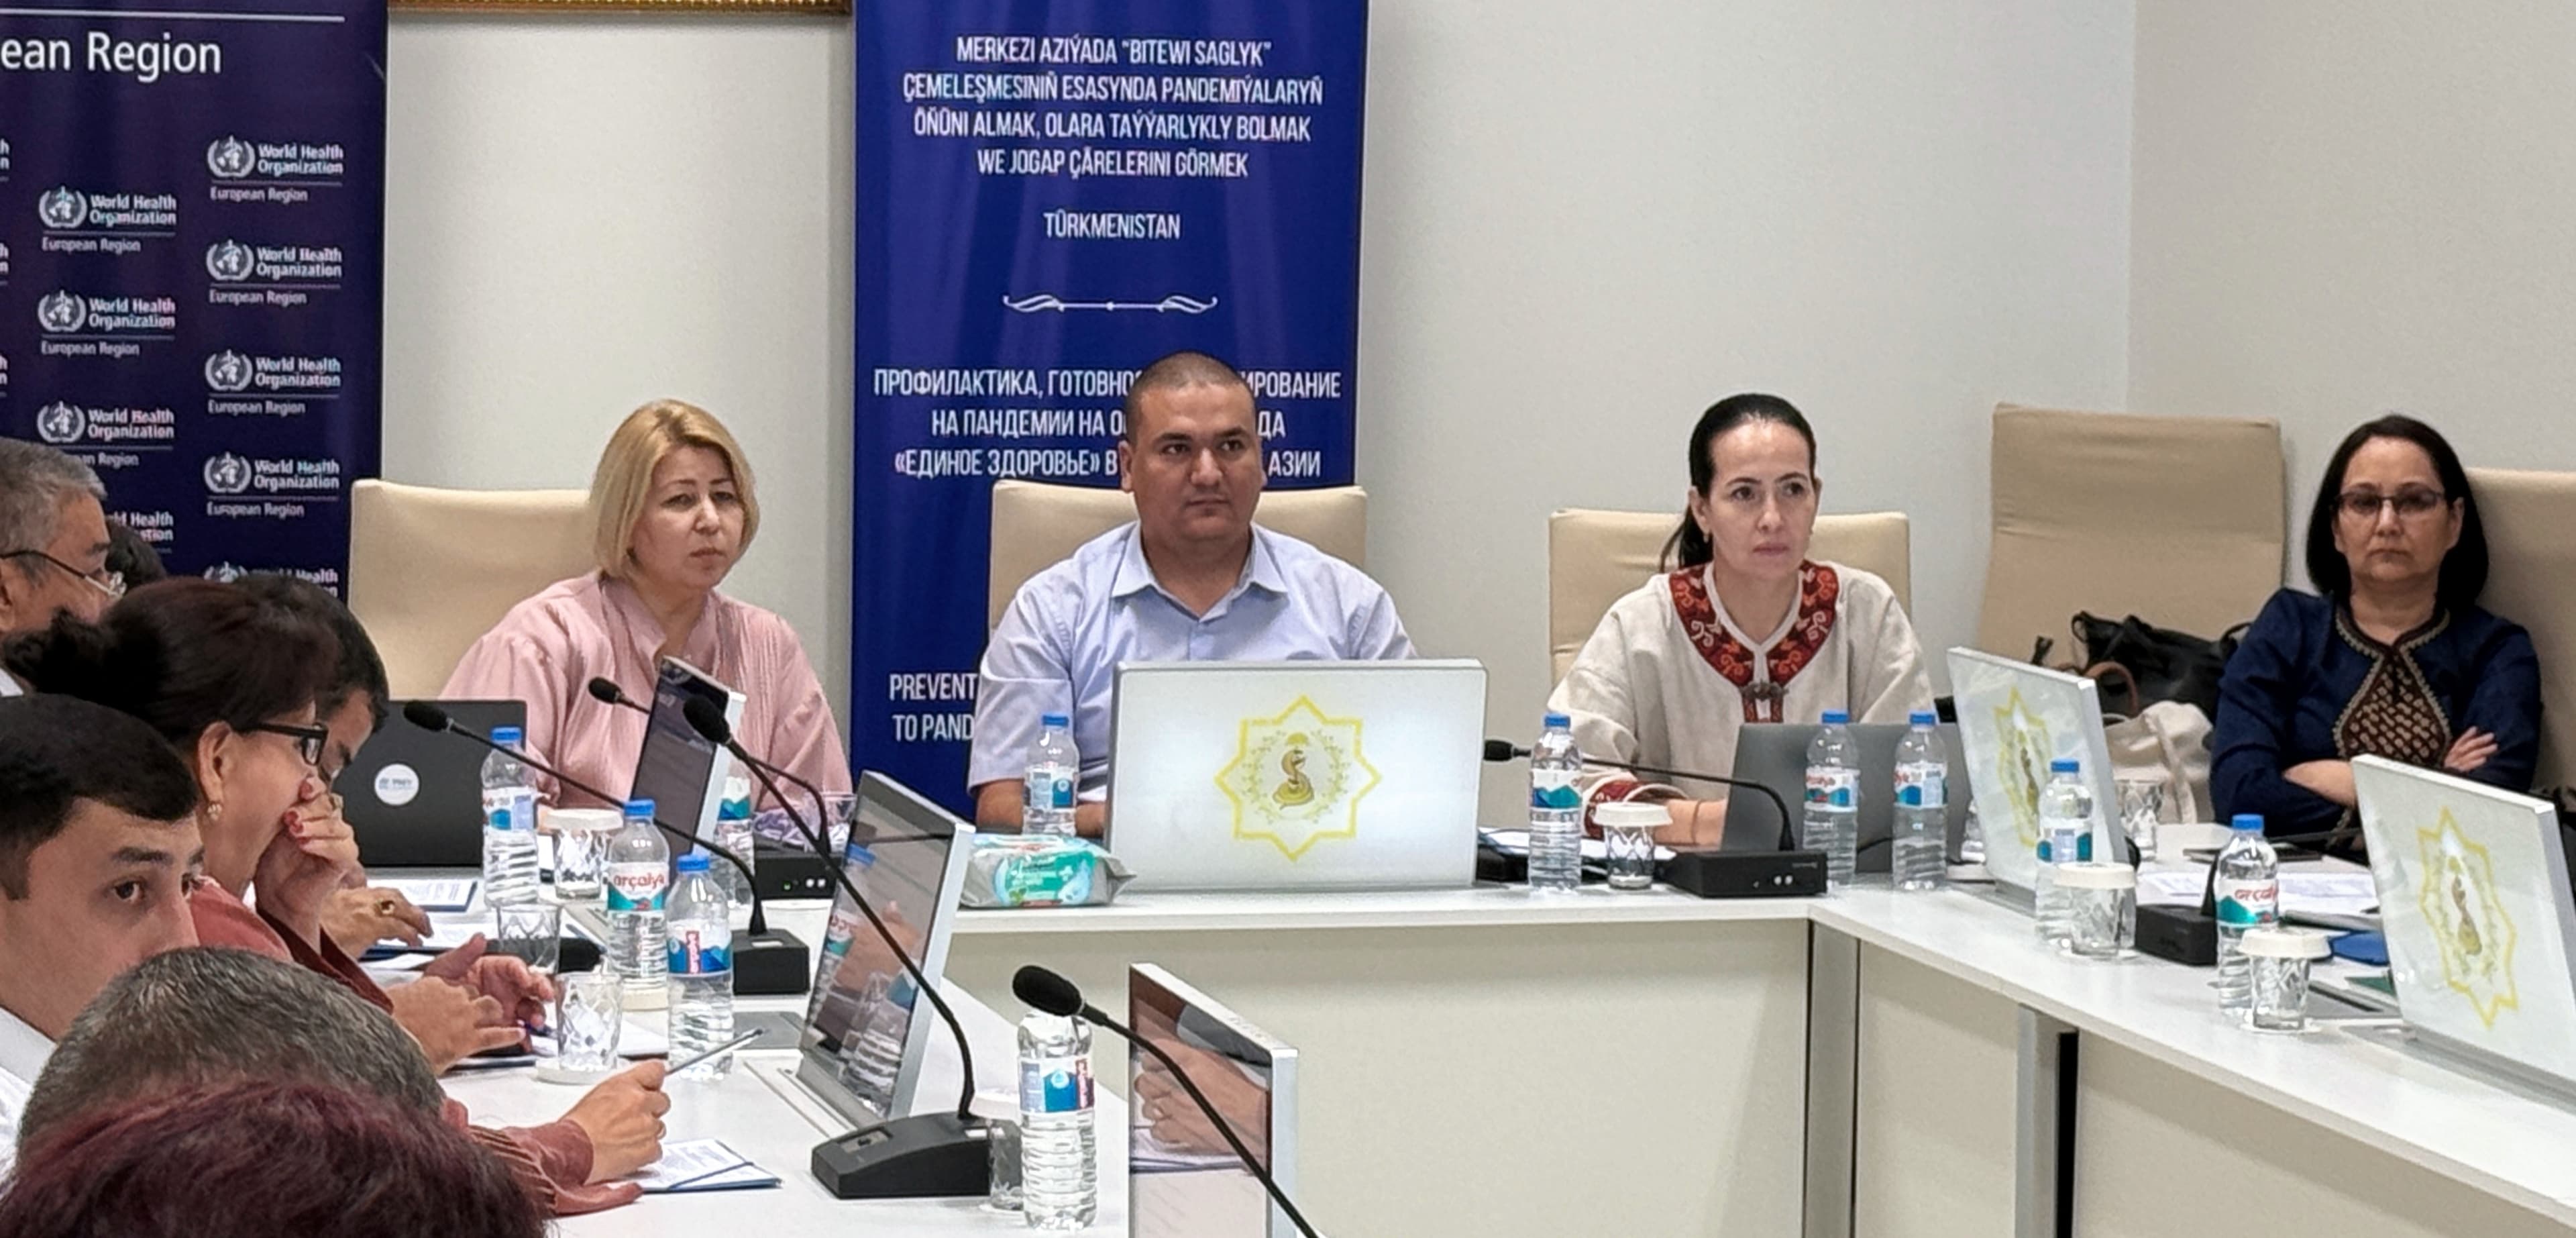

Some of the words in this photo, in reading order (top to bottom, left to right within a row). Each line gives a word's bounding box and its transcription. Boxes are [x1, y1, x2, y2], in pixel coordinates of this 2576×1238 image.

[87, 31, 222, 83] Region
[957, 37, 1035, 62] MERKEZI
[1040, 34, 1117, 64] AZIÝADA
[1063, 74, 1157, 101] ESASYNDA
[973, 111, 1041, 140] ALMAK,
[1045, 113, 1106, 138] OLARA
[1237, 115, 1311, 142] BOLMAK
[258, 143, 297, 159] World
[301, 144, 344, 159] Health
[257, 159, 344, 177] Organization
[978, 149, 1005, 174] WE
[1009, 149, 1065, 175] JOGAP
[90, 193, 130, 209] World
[133, 193, 177, 210] Health
[89, 209, 177, 228] Organization
[256, 247, 296, 262] World
[299, 247, 343, 262] Health
[256, 262, 343, 280] Organization
[89, 297, 129, 313] World
[132, 297, 176, 313] Health
[88, 313, 176, 331] Organization
[255, 356, 295, 372] World
[299, 357, 341, 372] Health
[254, 372, 341, 391] Organization
[874, 369, 1043, 398] ПРОФИЛАКТИКА,
[1048, 370, 1142, 396] ГОТОВНО
[88, 408, 128, 423] World
[131, 408, 175, 424] Health
[932, 410, 959, 435] НА
[963, 409, 1074, 439] ПАНДЕМИИ
[1079, 410, 1106, 436] НА
[87, 424, 175, 442] Organization
[254, 459, 294, 474] World
[297, 459, 340, 474] Health
[895, 448, 984, 478] «ЕДИНОЕ
[988, 449, 1101, 477] ЗДОРОВЬЕ»
[1105, 450, 1118, 475] В
[1268, 451, 1321, 477] АЗИИ
[254, 474, 340, 493] Organization
[130, 511, 174, 527] Health
[889, 673, 979, 701] PREVENT
[892, 714, 918, 741] TO
[922, 713, 975, 741] PAND
